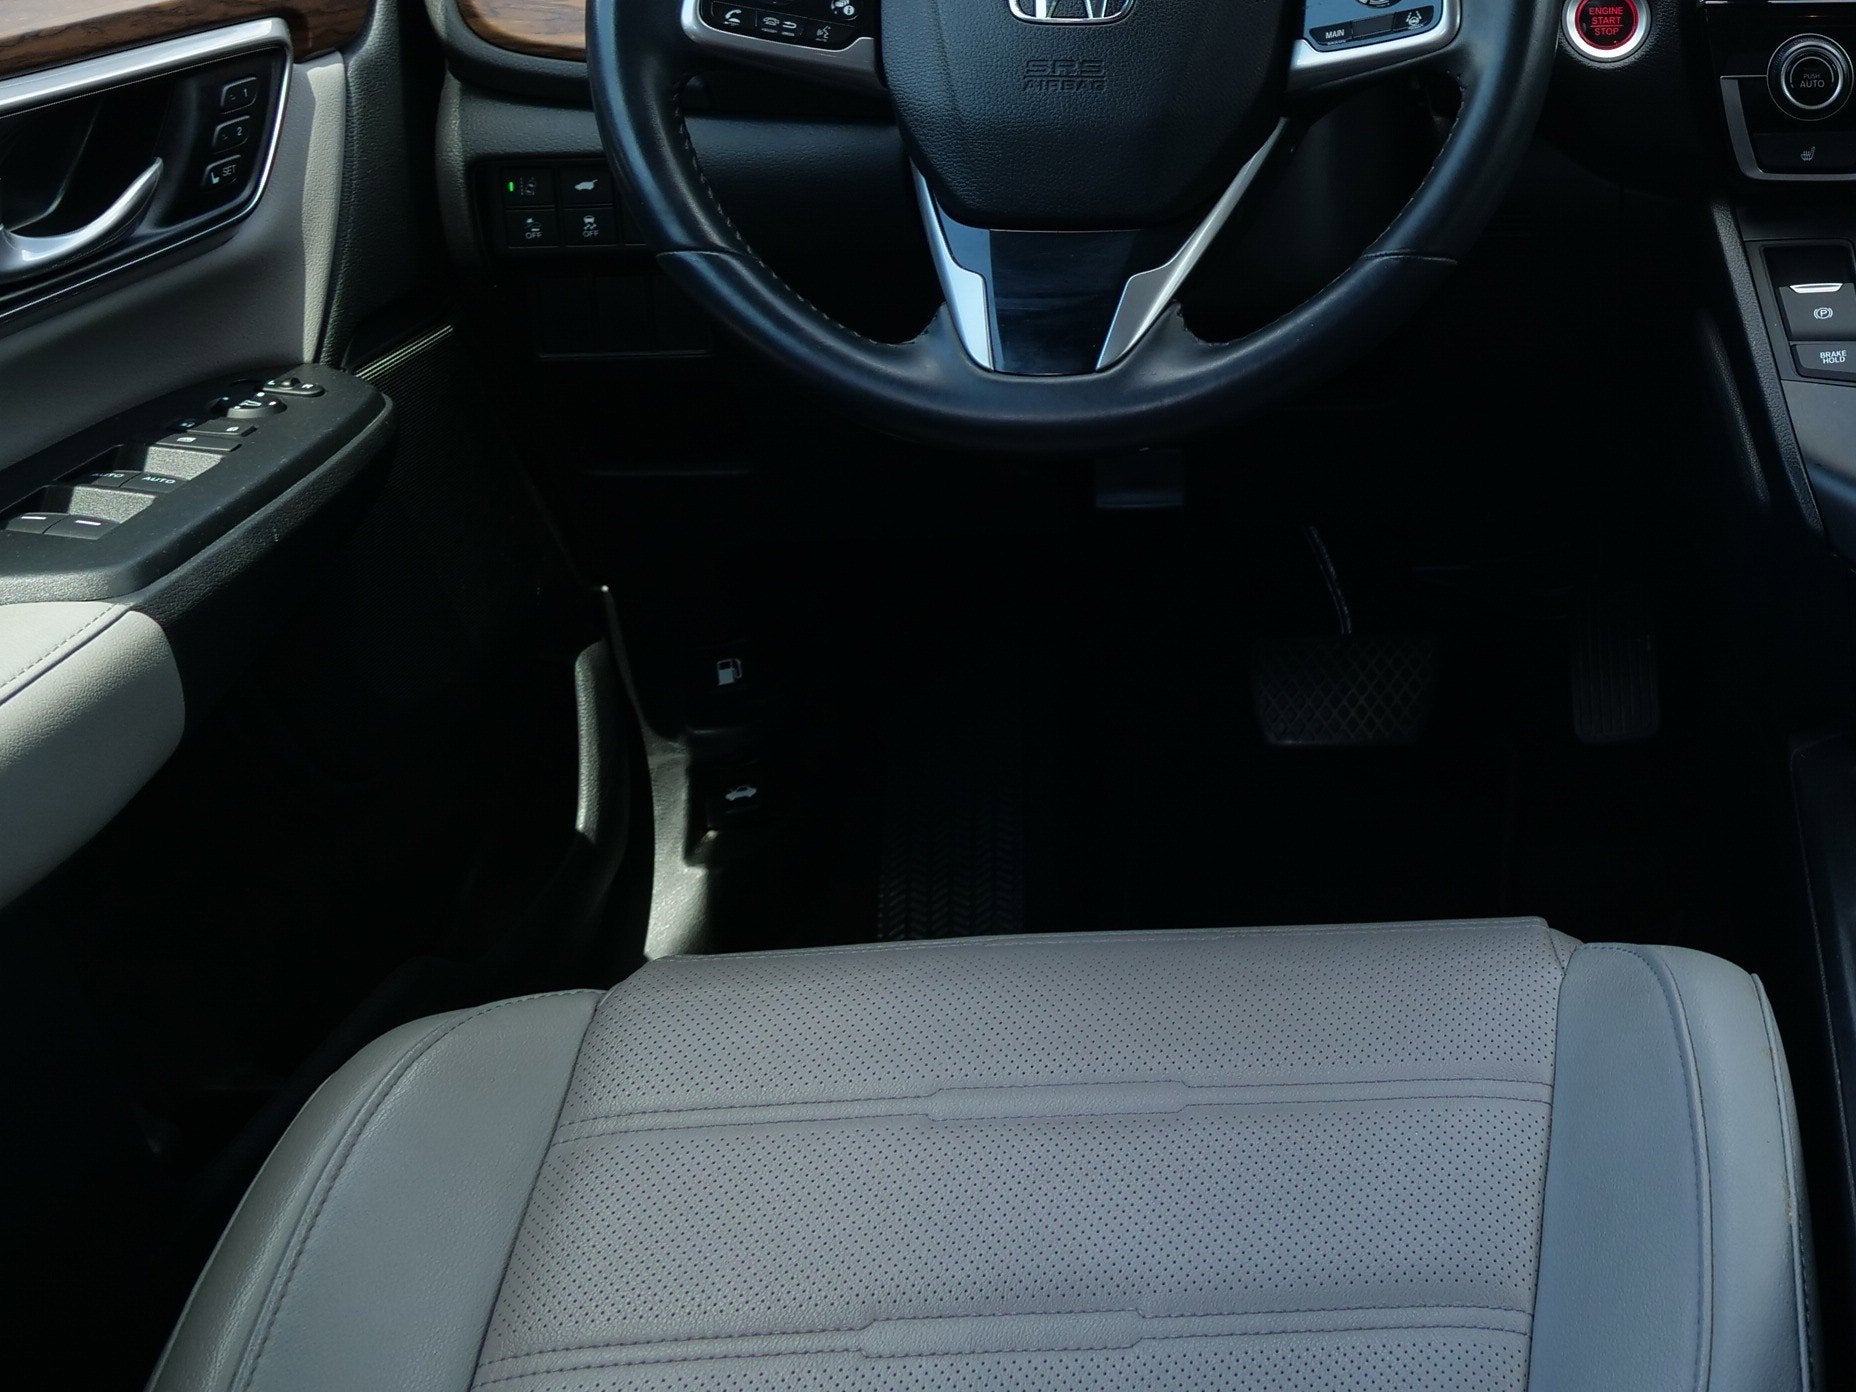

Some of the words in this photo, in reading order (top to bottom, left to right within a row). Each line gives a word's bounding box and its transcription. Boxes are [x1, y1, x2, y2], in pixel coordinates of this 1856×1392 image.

[1588, 6, 1624, 15] ENGINE
[1592, 16, 1622, 25] START
[1325, 28, 1345, 40] MAIN
[1594, 27, 1620, 36] STOP
[1800, 80, 1825, 88] AUTO
[236, 126, 244, 136] 2
[222, 164, 237, 177] SET
[582, 230, 599, 238] OFF
[1820, 349, 1847, 359] BRAKE
[1822, 356, 1846, 364] HOLD
[141, 475, 176, 484] AUTO
